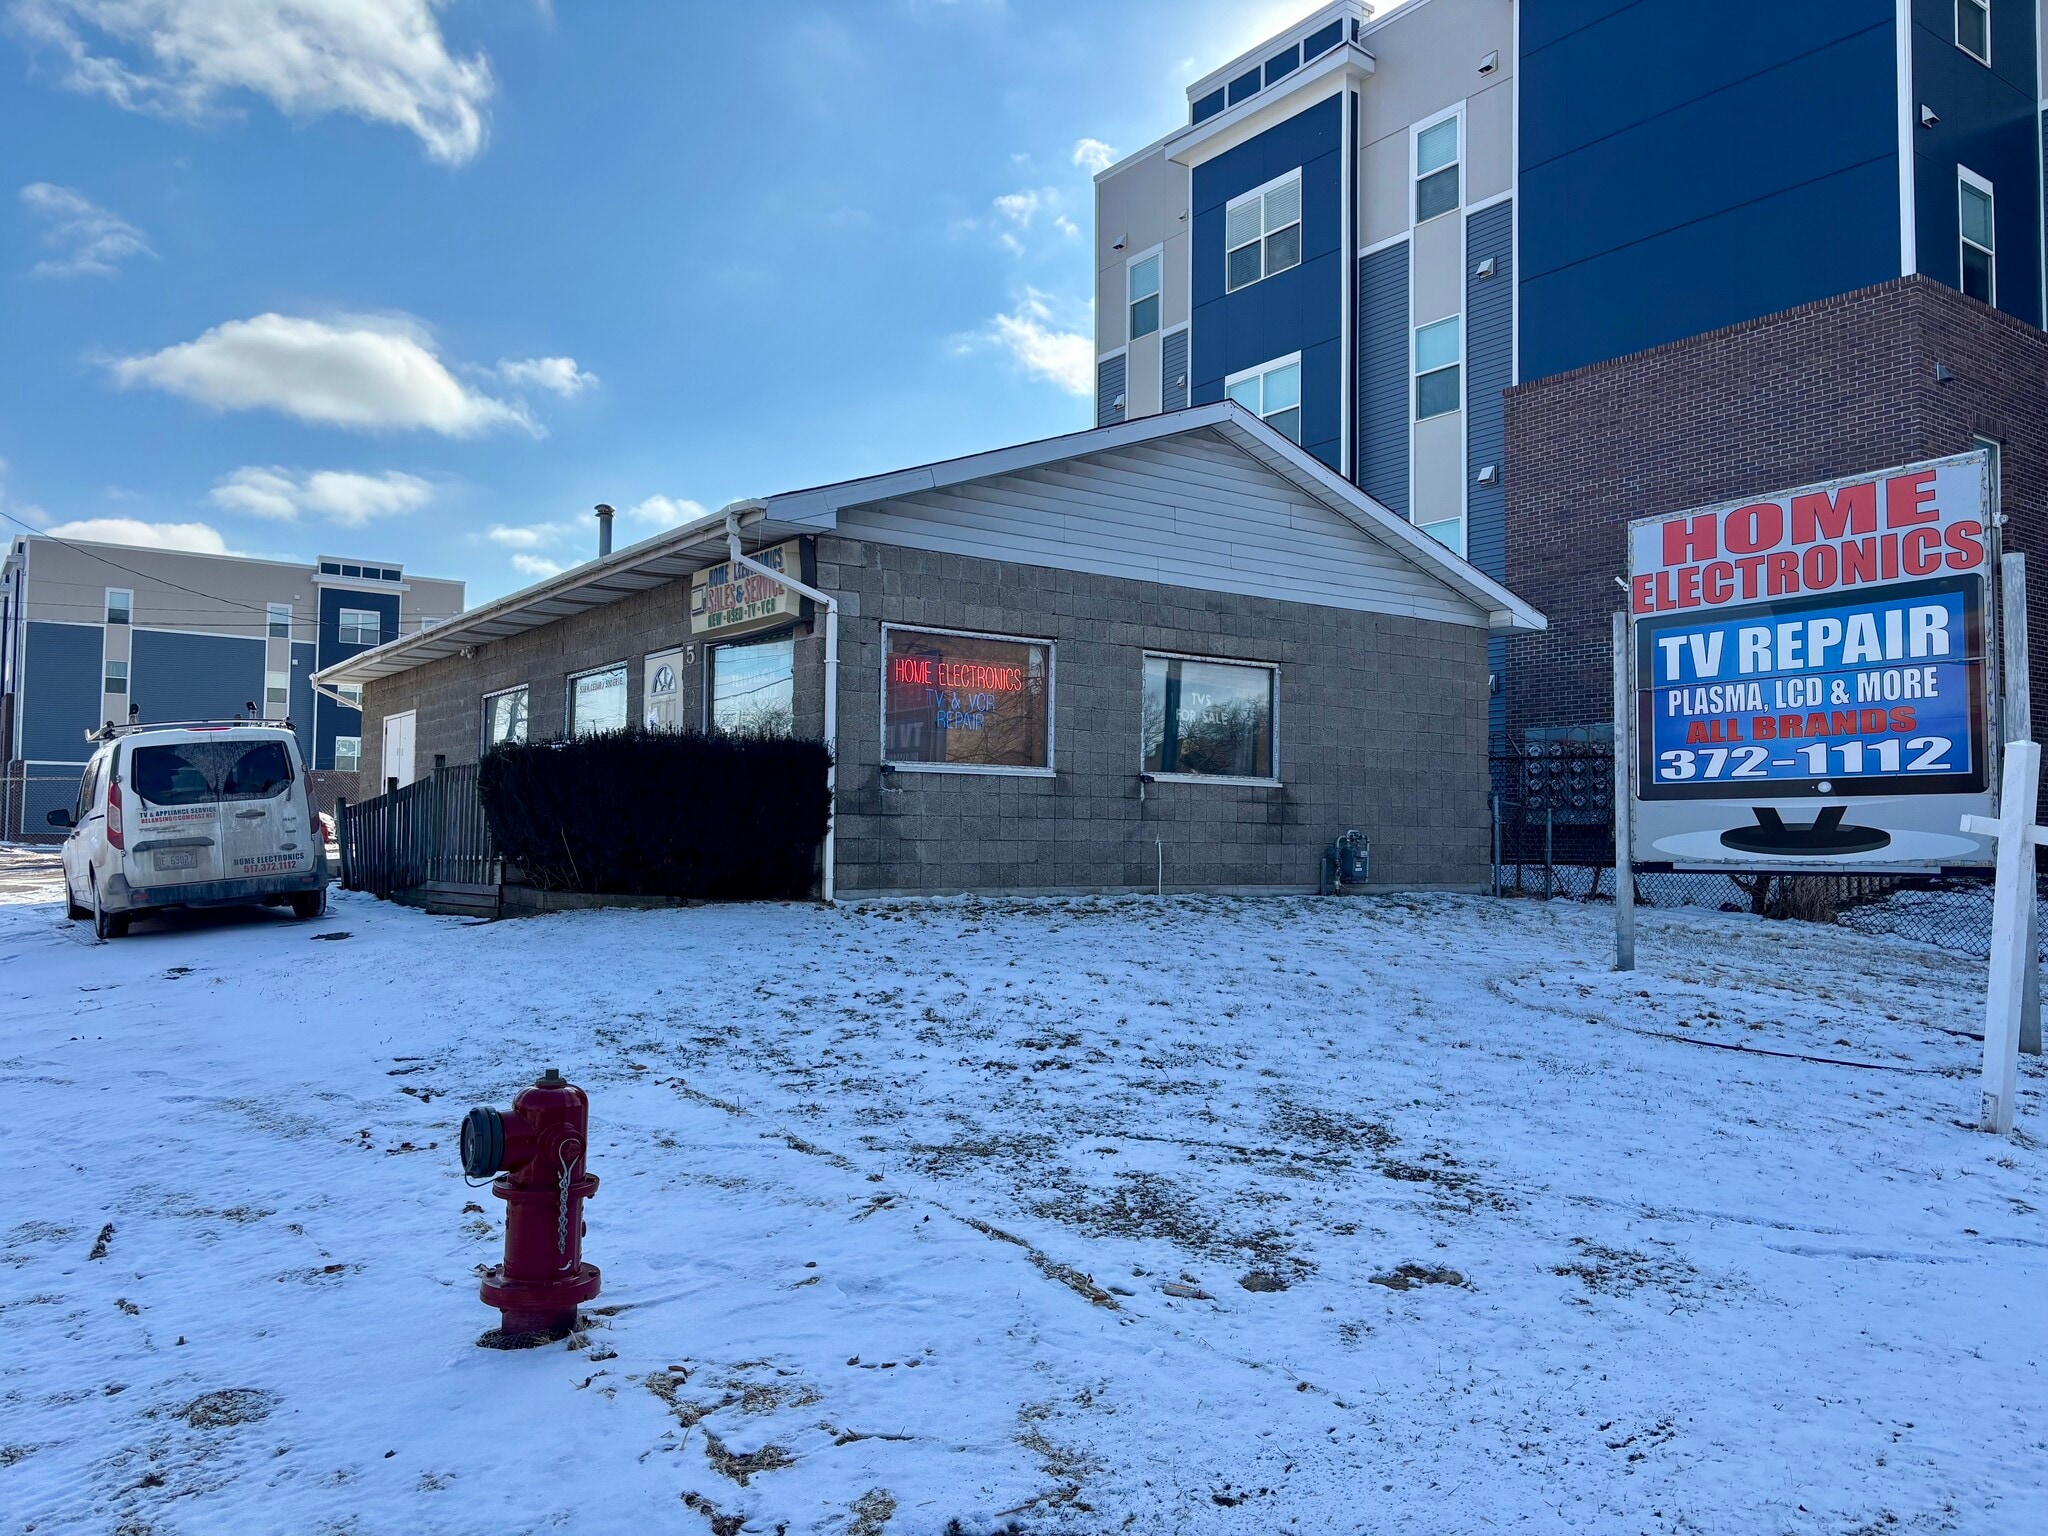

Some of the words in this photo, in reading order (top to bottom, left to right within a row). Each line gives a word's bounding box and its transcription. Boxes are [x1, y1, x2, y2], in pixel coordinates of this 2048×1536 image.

[1662, 469, 1940, 567] HOME
[709, 564, 730, 589] HOME
[1632, 520, 1984, 615] ELECTRONICS
[708, 584, 736, 614] SALES
[736, 585, 744, 604] &
[708, 612, 722, 628] NEW
[727, 606, 743, 623] USED
[747, 603, 757, 618] TV
[761, 598, 776, 615] VCR
[686, 646, 696, 665] 5
[1658, 630, 1725, 682] TV
[1738, 605, 1951, 675] REPAIR
[895, 658, 933, 685] HOME
[938, 663, 1023, 692] ELECTRONICS
[925, 688, 945, 709] TV
[951, 692, 961, 711] &
[968, 692, 996, 713] VCR
[1191, 693, 1212, 706] TVS
[1668, 681, 1769, 717] PLASMA,
[1774, 677, 1825, 710] LCD
[1829, 679, 1850, 704] &
[1856, 666, 1939, 703] MORE
[938, 710, 985, 731] REPAIR
[1176, 708, 1196, 723] FOR
[1202, 712, 1229, 726] SALE
[1686, 718, 1743, 745] ALL
[1753, 706, 1917, 741] BRANDS
[1660, 736, 1952, 781] 372-1112
[156, 808, 189, 817] APPLIANCE
[190, 806, 217, 815] SERVICE
[234, 857, 255, 867] HOME
[257, 852, 305, 864] ELECTRONICS
[244, 860, 297, 874] 517.372.1112
